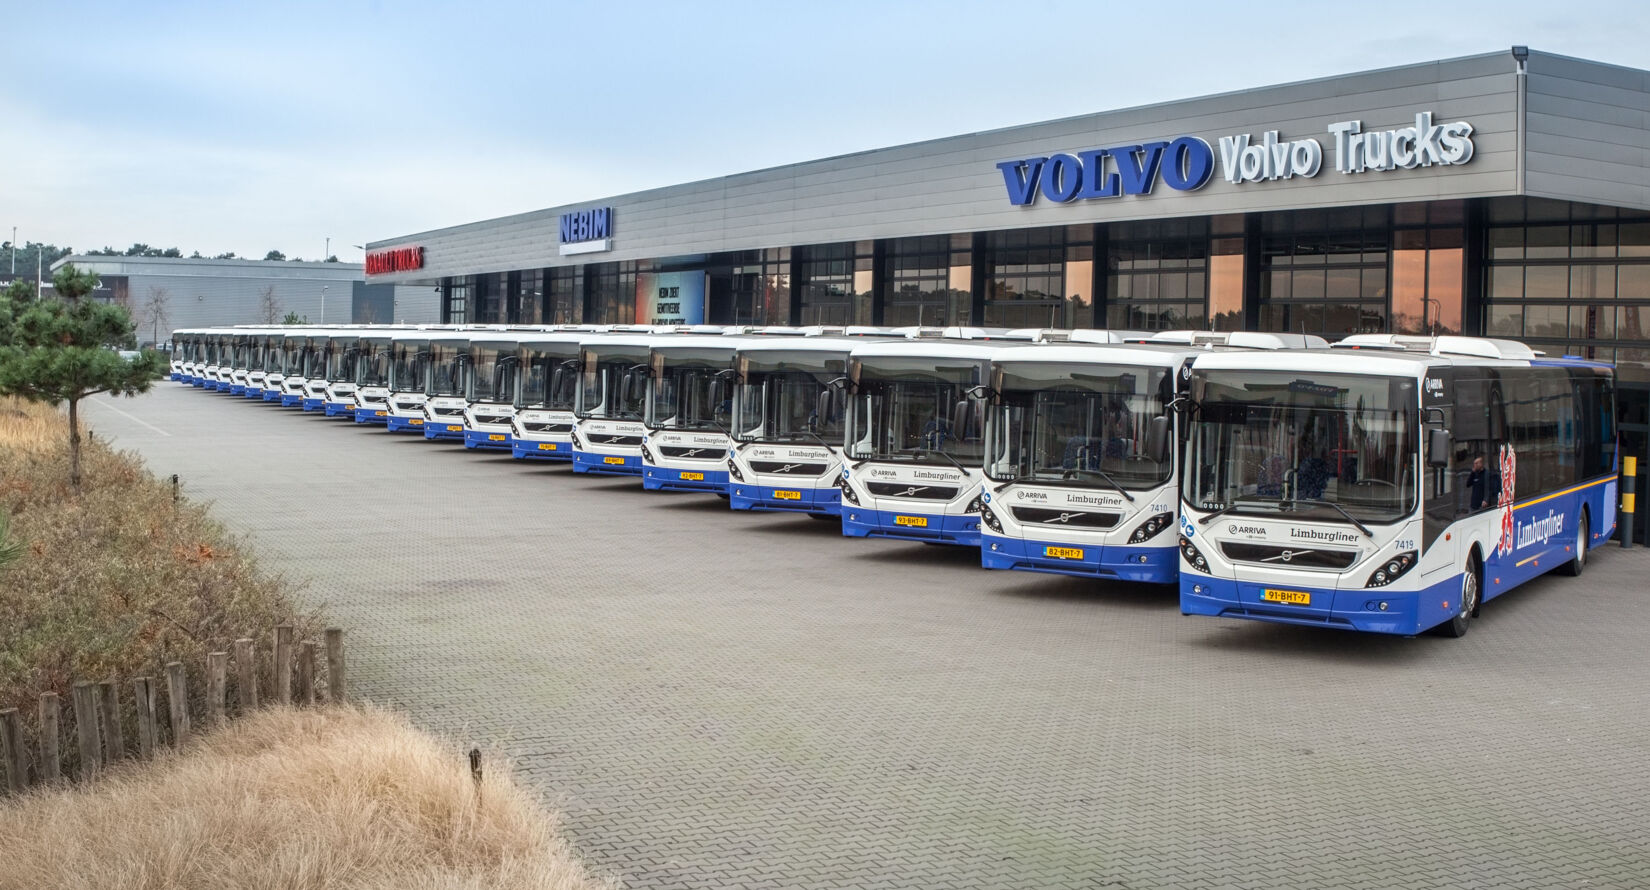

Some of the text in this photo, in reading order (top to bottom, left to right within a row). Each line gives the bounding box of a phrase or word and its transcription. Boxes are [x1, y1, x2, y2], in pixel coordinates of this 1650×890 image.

[1218, 111, 1475, 184] Volvo Trucks
[996, 136, 1216, 207] VOLVO
[559, 207, 611, 243] NEBIM
[788, 450, 829, 459] Limburgliner
[914, 470, 961, 481] Limburgliner
[1067, 494, 1122, 506] Limburgliner
[1151, 504, 1168, 512] 7410
[898, 517, 925, 525] 93-BHT-7
[1238, 526, 1267, 535] ARRIVA
[1290, 528, 1359, 542] Limburgliner
[1516, 509, 1564, 550] Limburgliner
[1395, 540, 1414, 550] 7419
[1048, 548, 1081, 557] 82-BHT-7
[1268, 591, 1306, 602] 91-BHT-7
